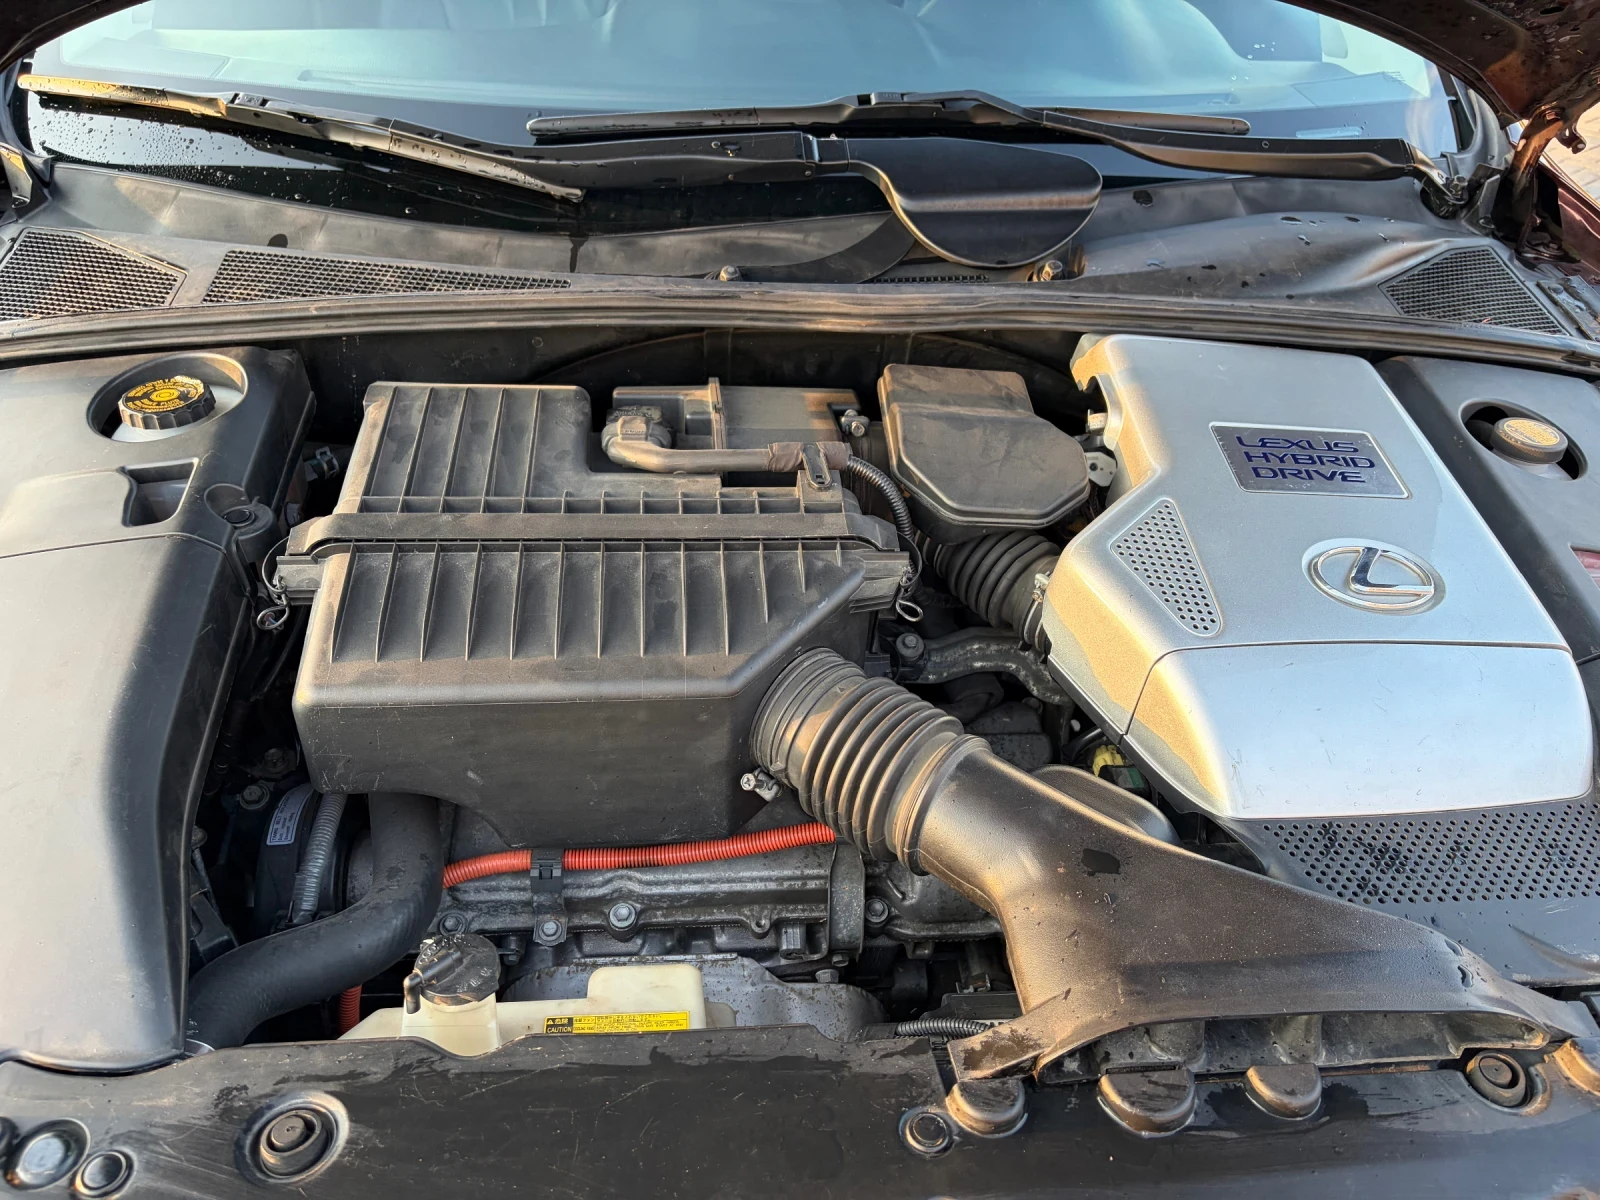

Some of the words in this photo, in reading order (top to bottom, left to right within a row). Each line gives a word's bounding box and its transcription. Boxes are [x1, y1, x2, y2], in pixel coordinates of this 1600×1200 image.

[1235, 436, 1359, 453] LEXUS
[1243, 451, 1376, 469] HYBRID
[1251, 466, 1366, 483] DRIVE
[546, 1026, 572, 1034] CAUTION
